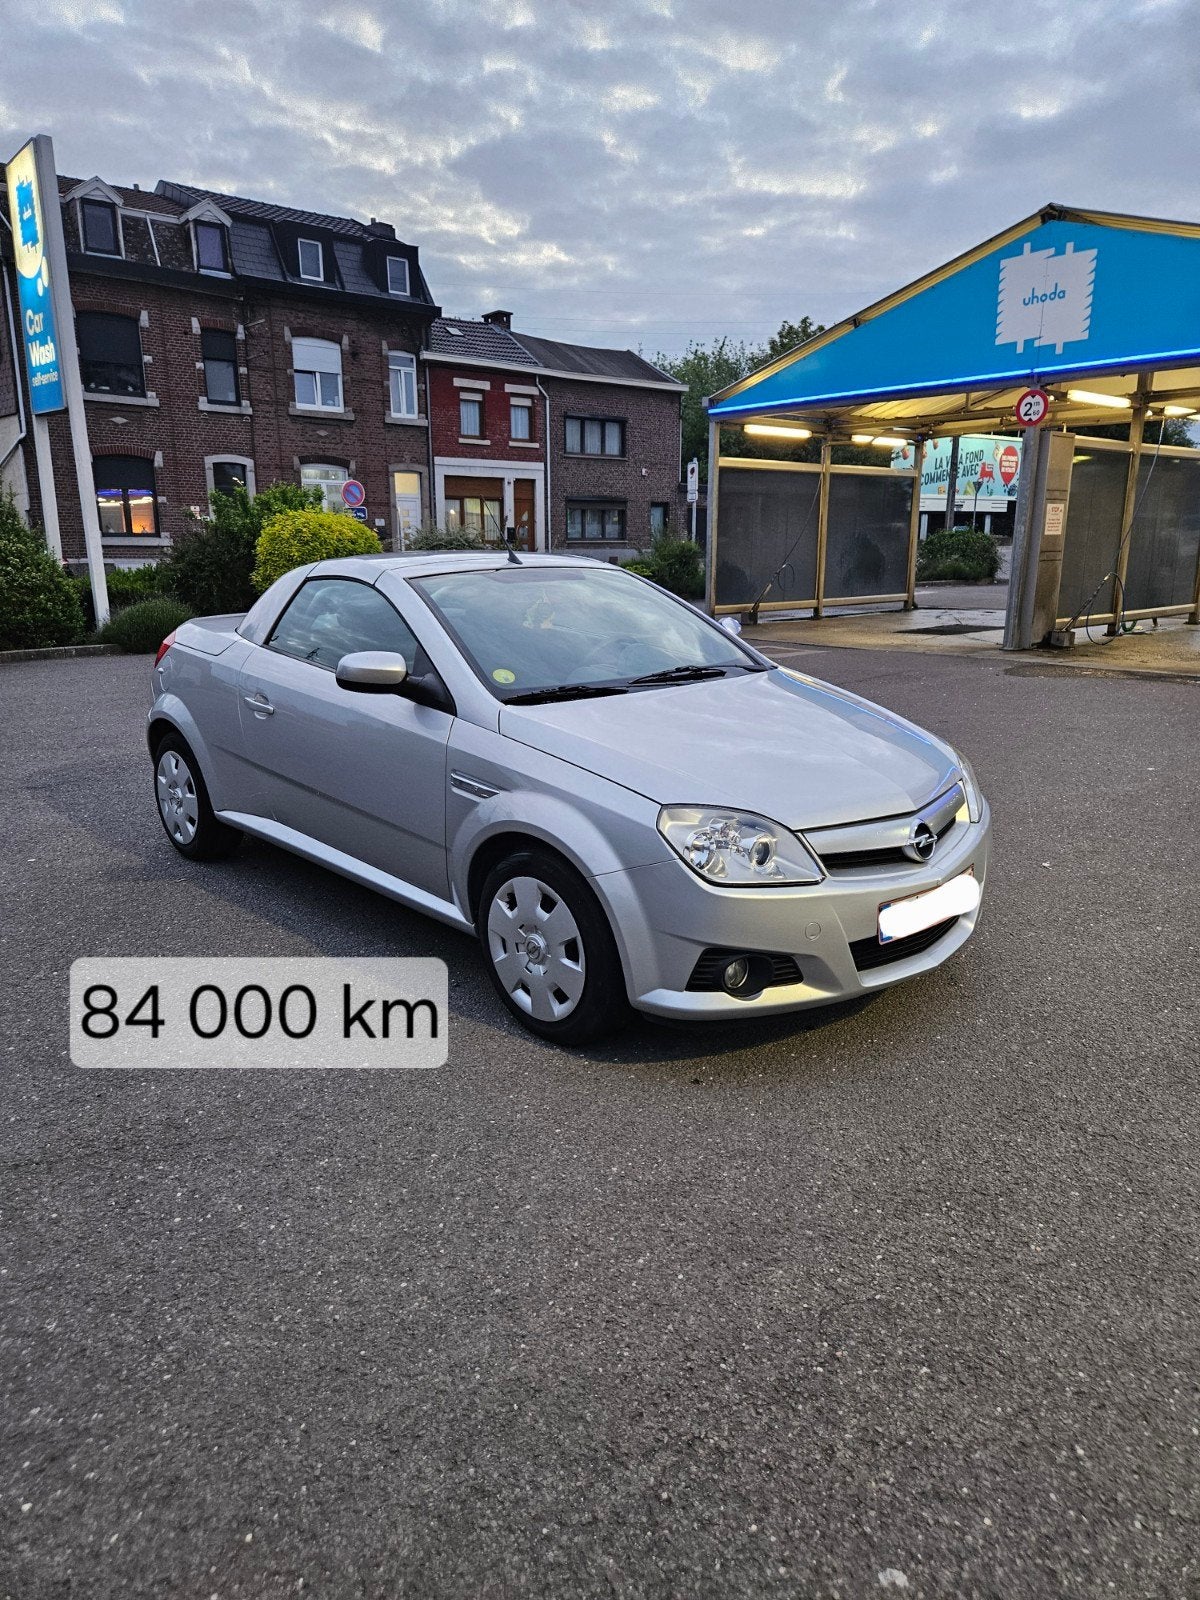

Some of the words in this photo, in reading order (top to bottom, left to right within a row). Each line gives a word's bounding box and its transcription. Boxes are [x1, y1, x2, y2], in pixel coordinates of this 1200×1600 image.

[1022, 282, 1066, 306] uhoda
[25, 308, 44, 336] Car
[28, 335, 56, 367] Wash
[32, 368, 58, 387] self-service
[1023, 401, 1033, 417] 2
[934, 457, 943, 470] LA
[965, 449, 984, 464] FOND
[920, 466, 960, 486] COMMENE
[961, 463, 979, 478] AVEC
